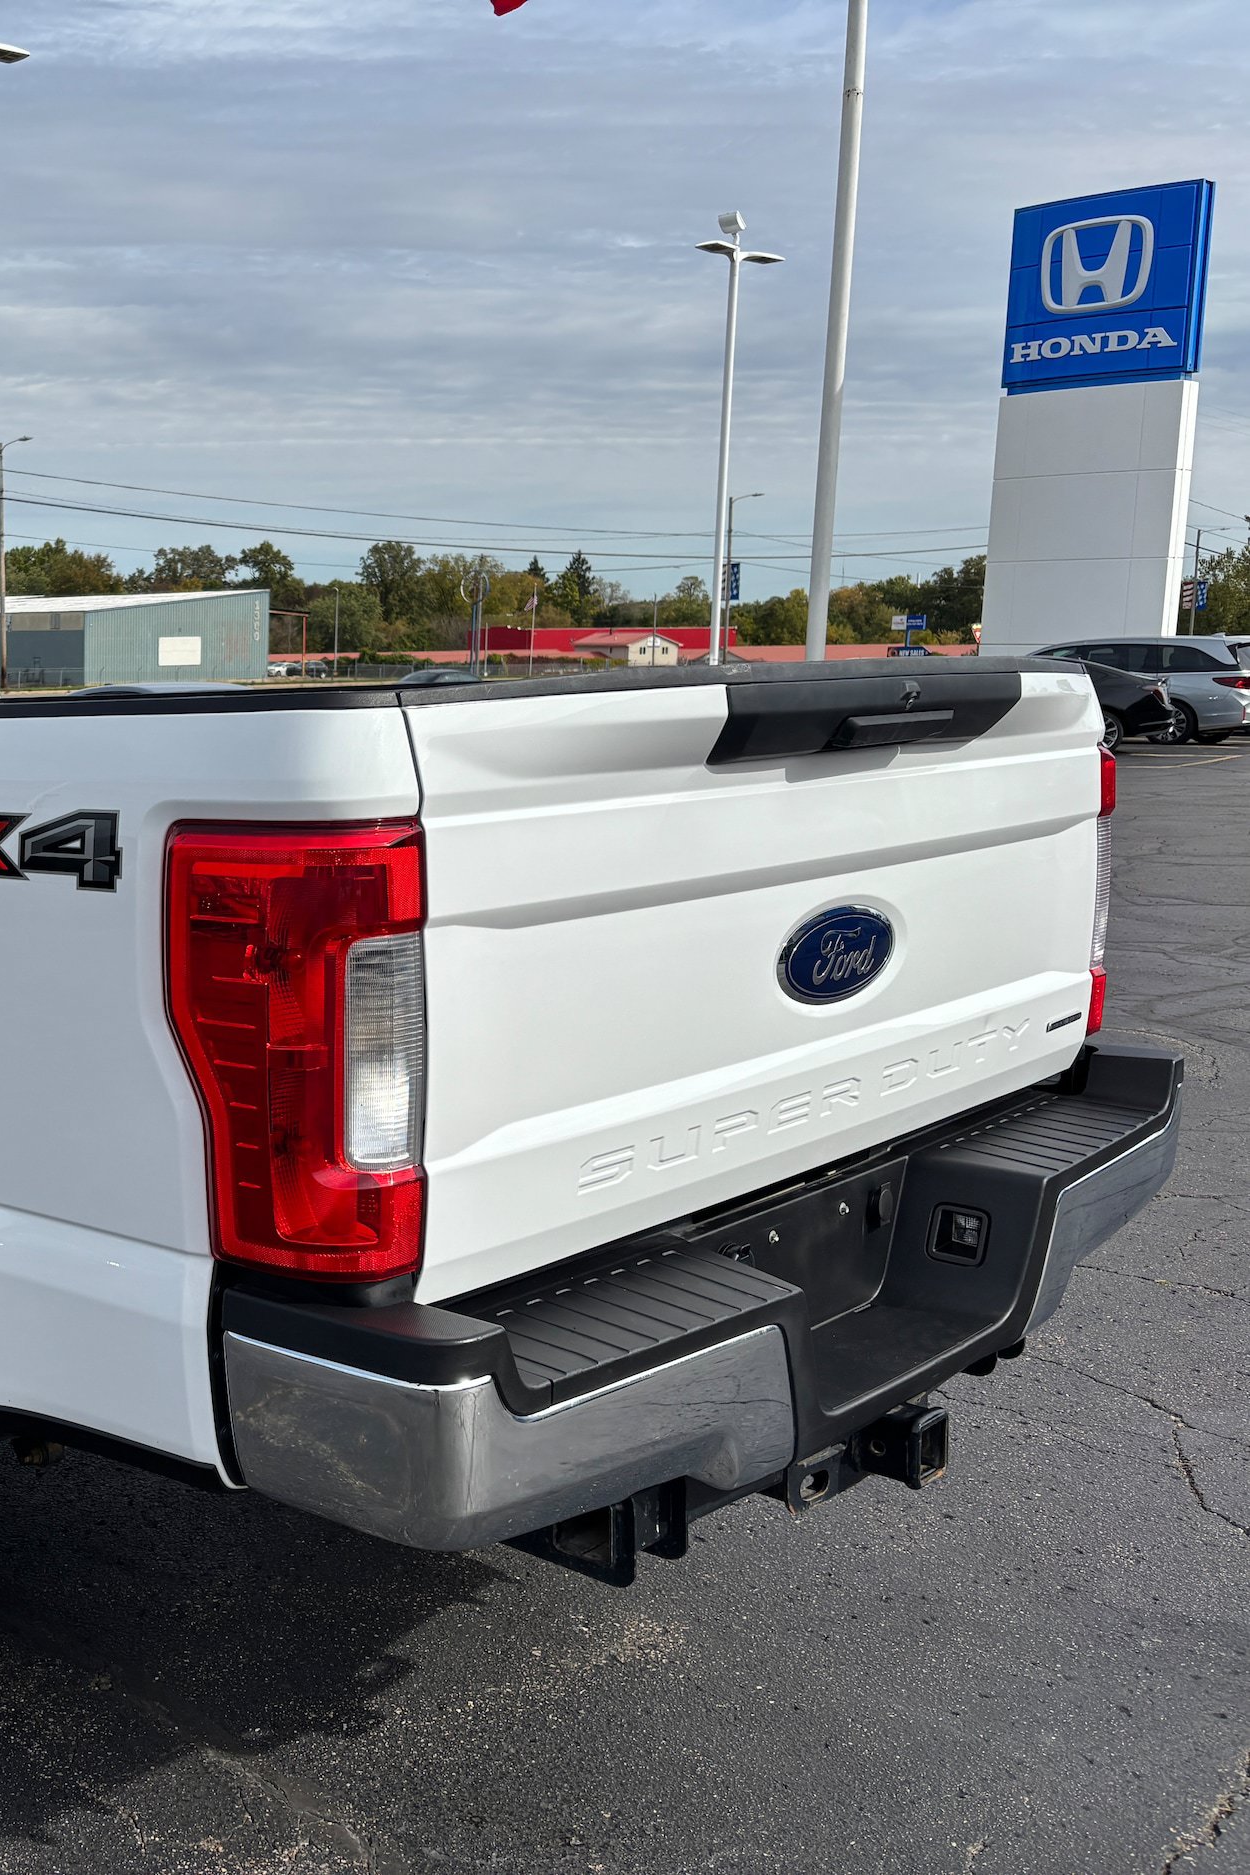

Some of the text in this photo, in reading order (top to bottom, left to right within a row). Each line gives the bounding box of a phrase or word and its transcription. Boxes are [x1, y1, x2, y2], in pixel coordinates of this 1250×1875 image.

[1009, 326, 1178, 364] HONDA
[812, 927, 877, 985] Ford
[577, 1017, 1032, 1196] SUPER DUTY
